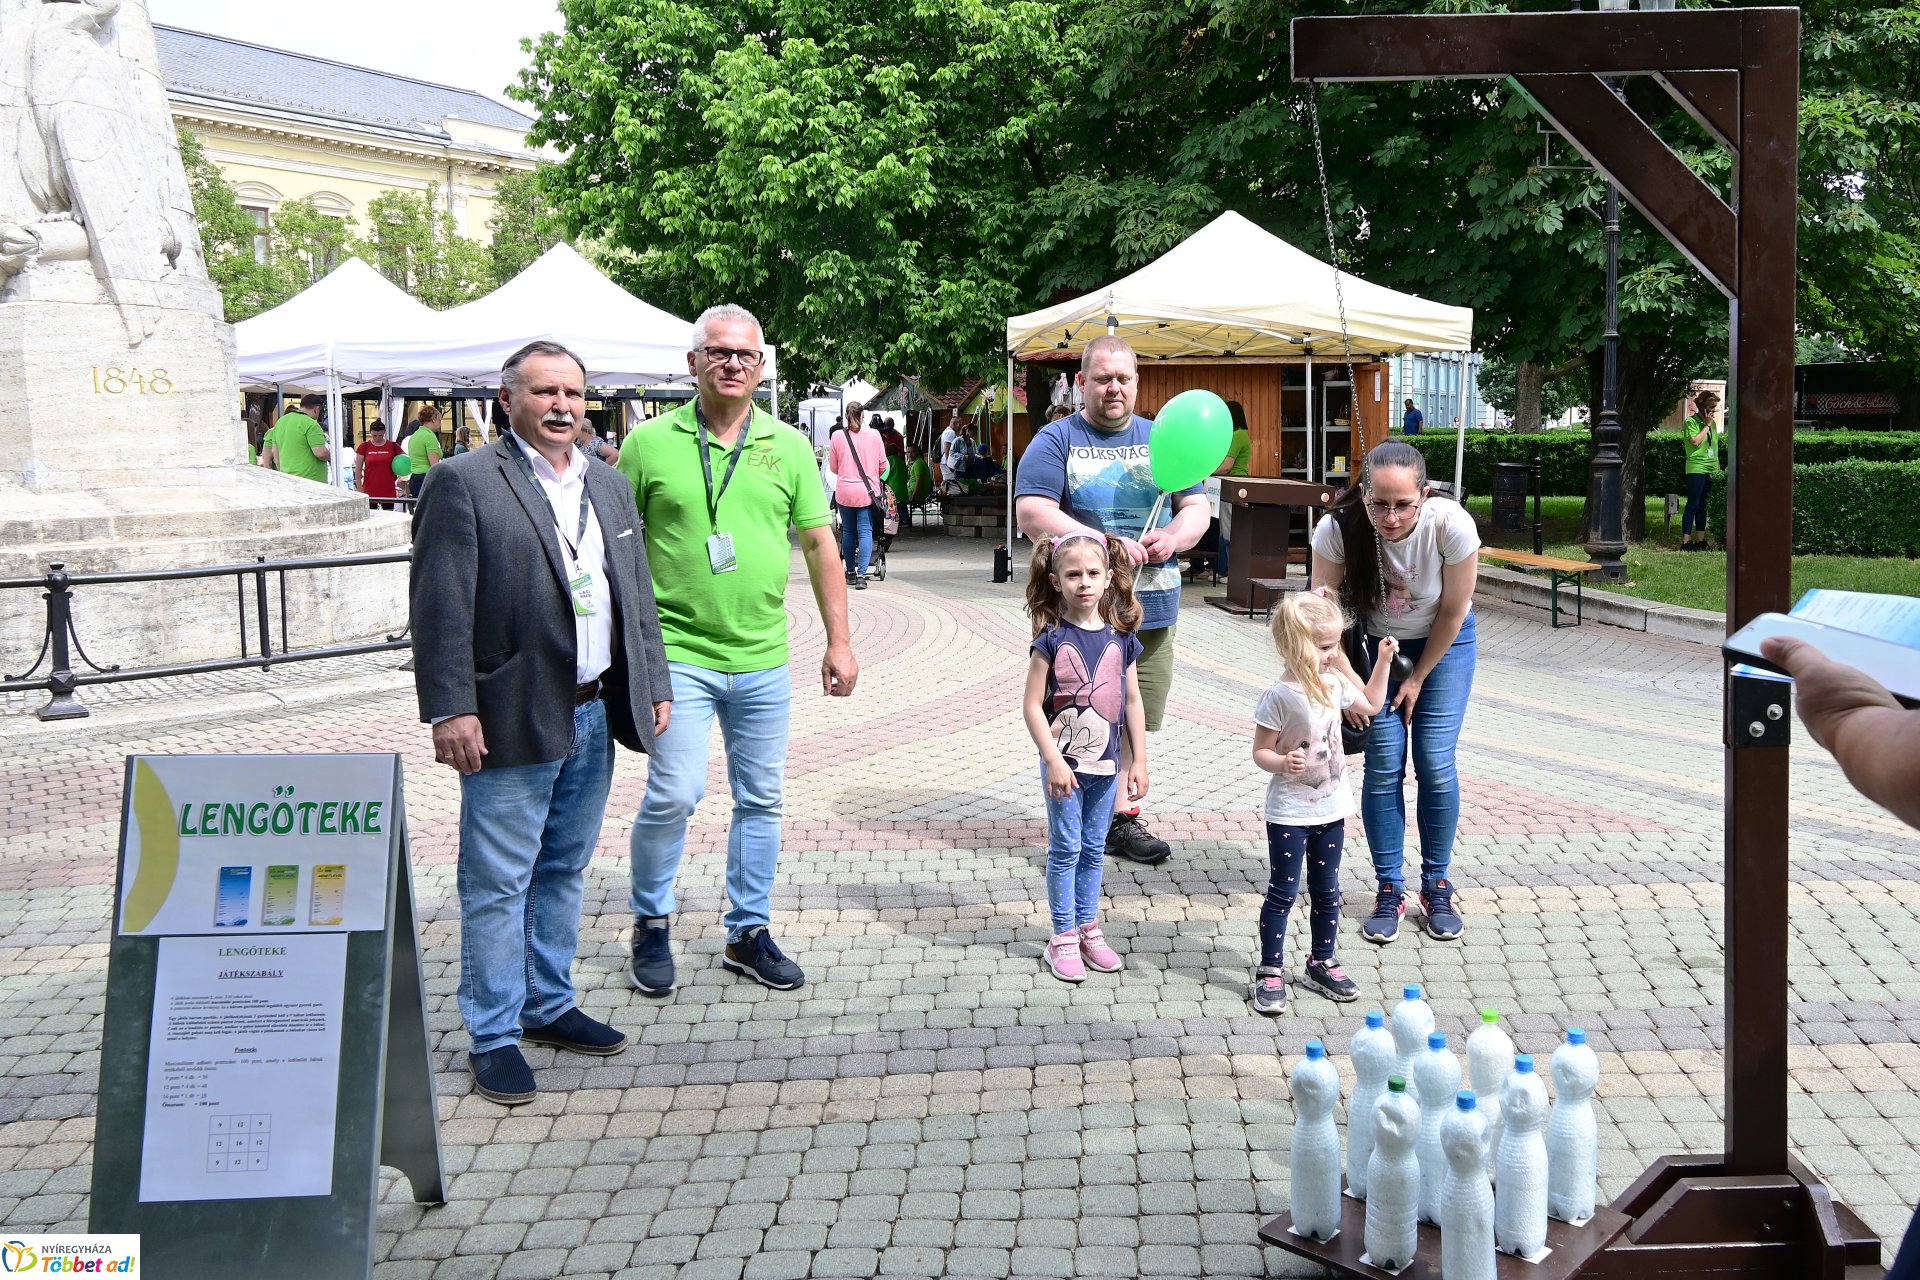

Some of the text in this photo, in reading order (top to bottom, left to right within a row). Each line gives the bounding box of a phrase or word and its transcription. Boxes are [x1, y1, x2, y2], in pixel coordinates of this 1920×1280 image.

[88, 366, 174, 394] 1848
[1069, 446, 1149, 460] VOLKSWAG
[747, 452, 782, 472] EAK
[179, 785, 383, 836] LENGŐTEKE
[218, 946, 287, 957] LENGŐTEKE
[218, 969, 284, 979] JÁTÉKSZABÁLY
